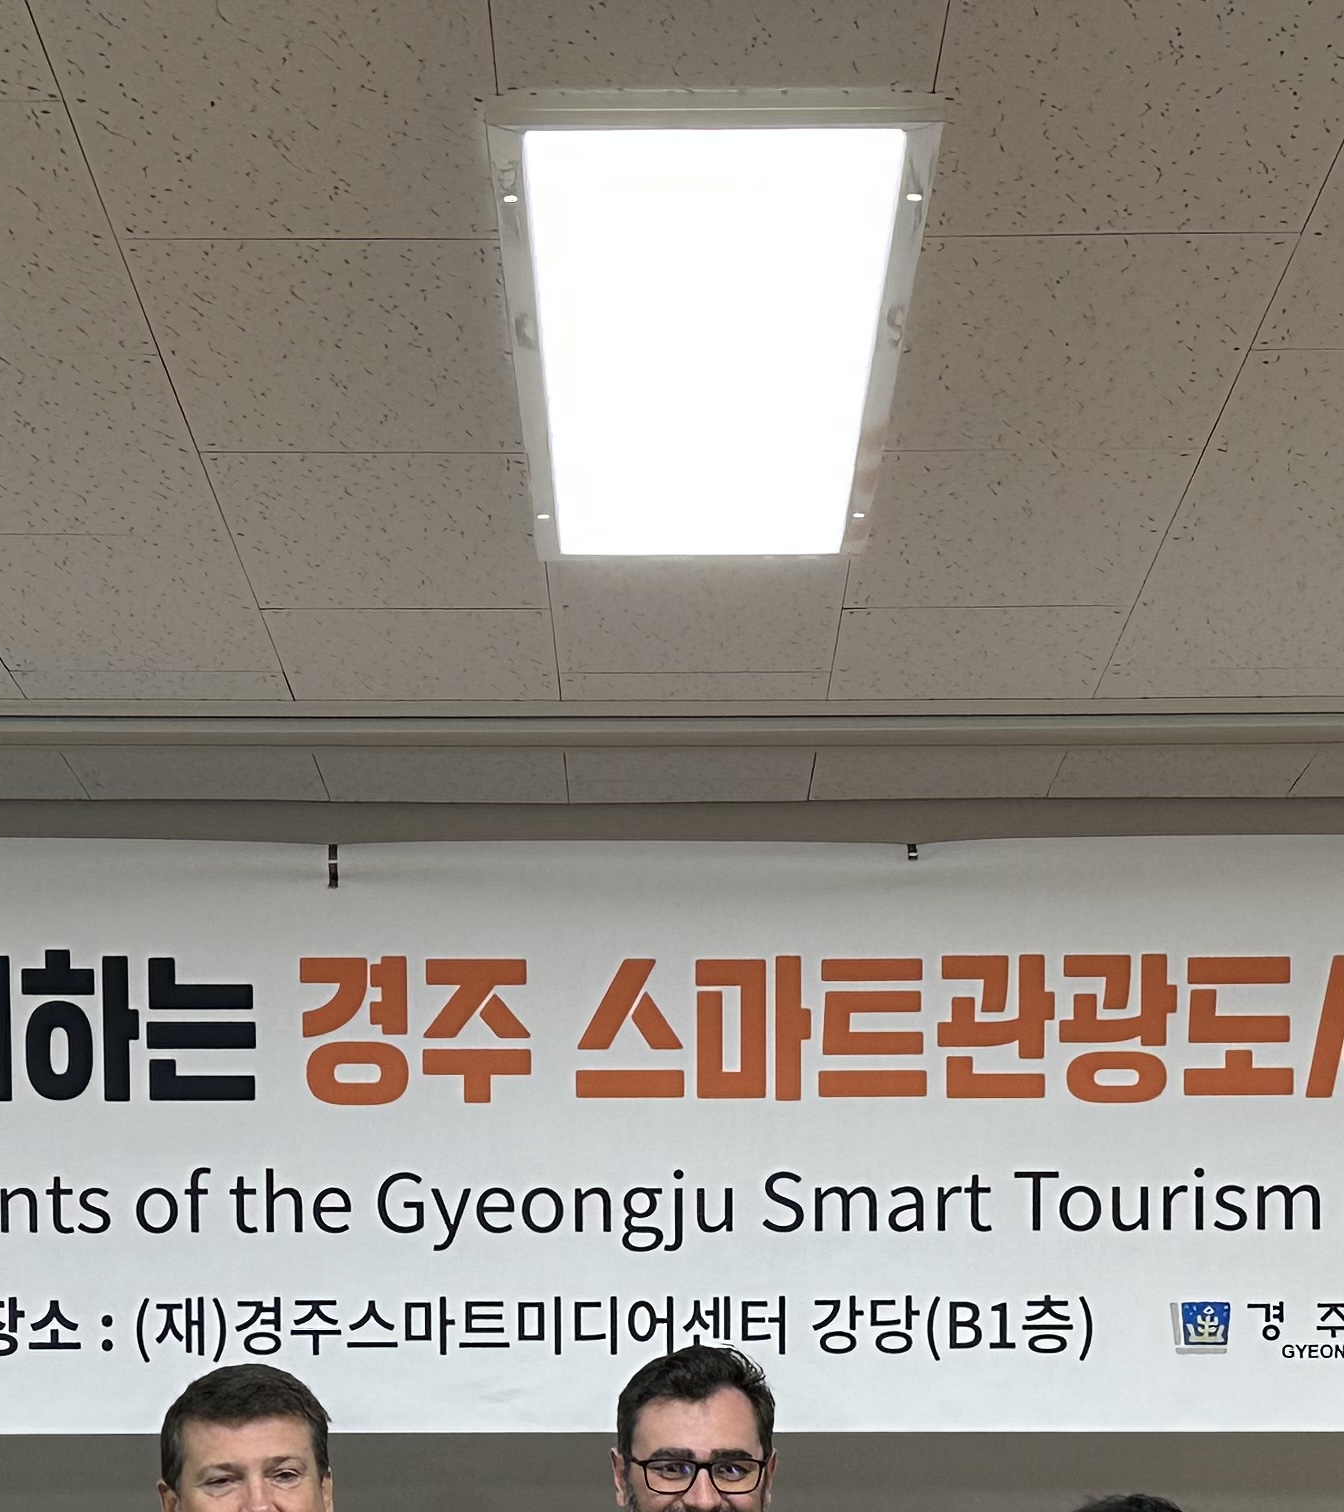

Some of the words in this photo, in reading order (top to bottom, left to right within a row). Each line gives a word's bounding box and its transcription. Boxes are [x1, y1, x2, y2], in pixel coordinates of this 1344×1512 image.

[299, 955, 532, 1105] 경주
[135, 1166, 212, 1235] of
[228, 1167, 352, 1235] the
[376, 1168, 734, 1253] Gyeongju
[762, 1170, 993, 1234] Smart
[1013, 1167, 1321, 1233] Tourism
[135, 1295, 786, 1362] (재)경주스마트미디어센터
[811, 1294, 1093, 1362] 강당(B1층)
